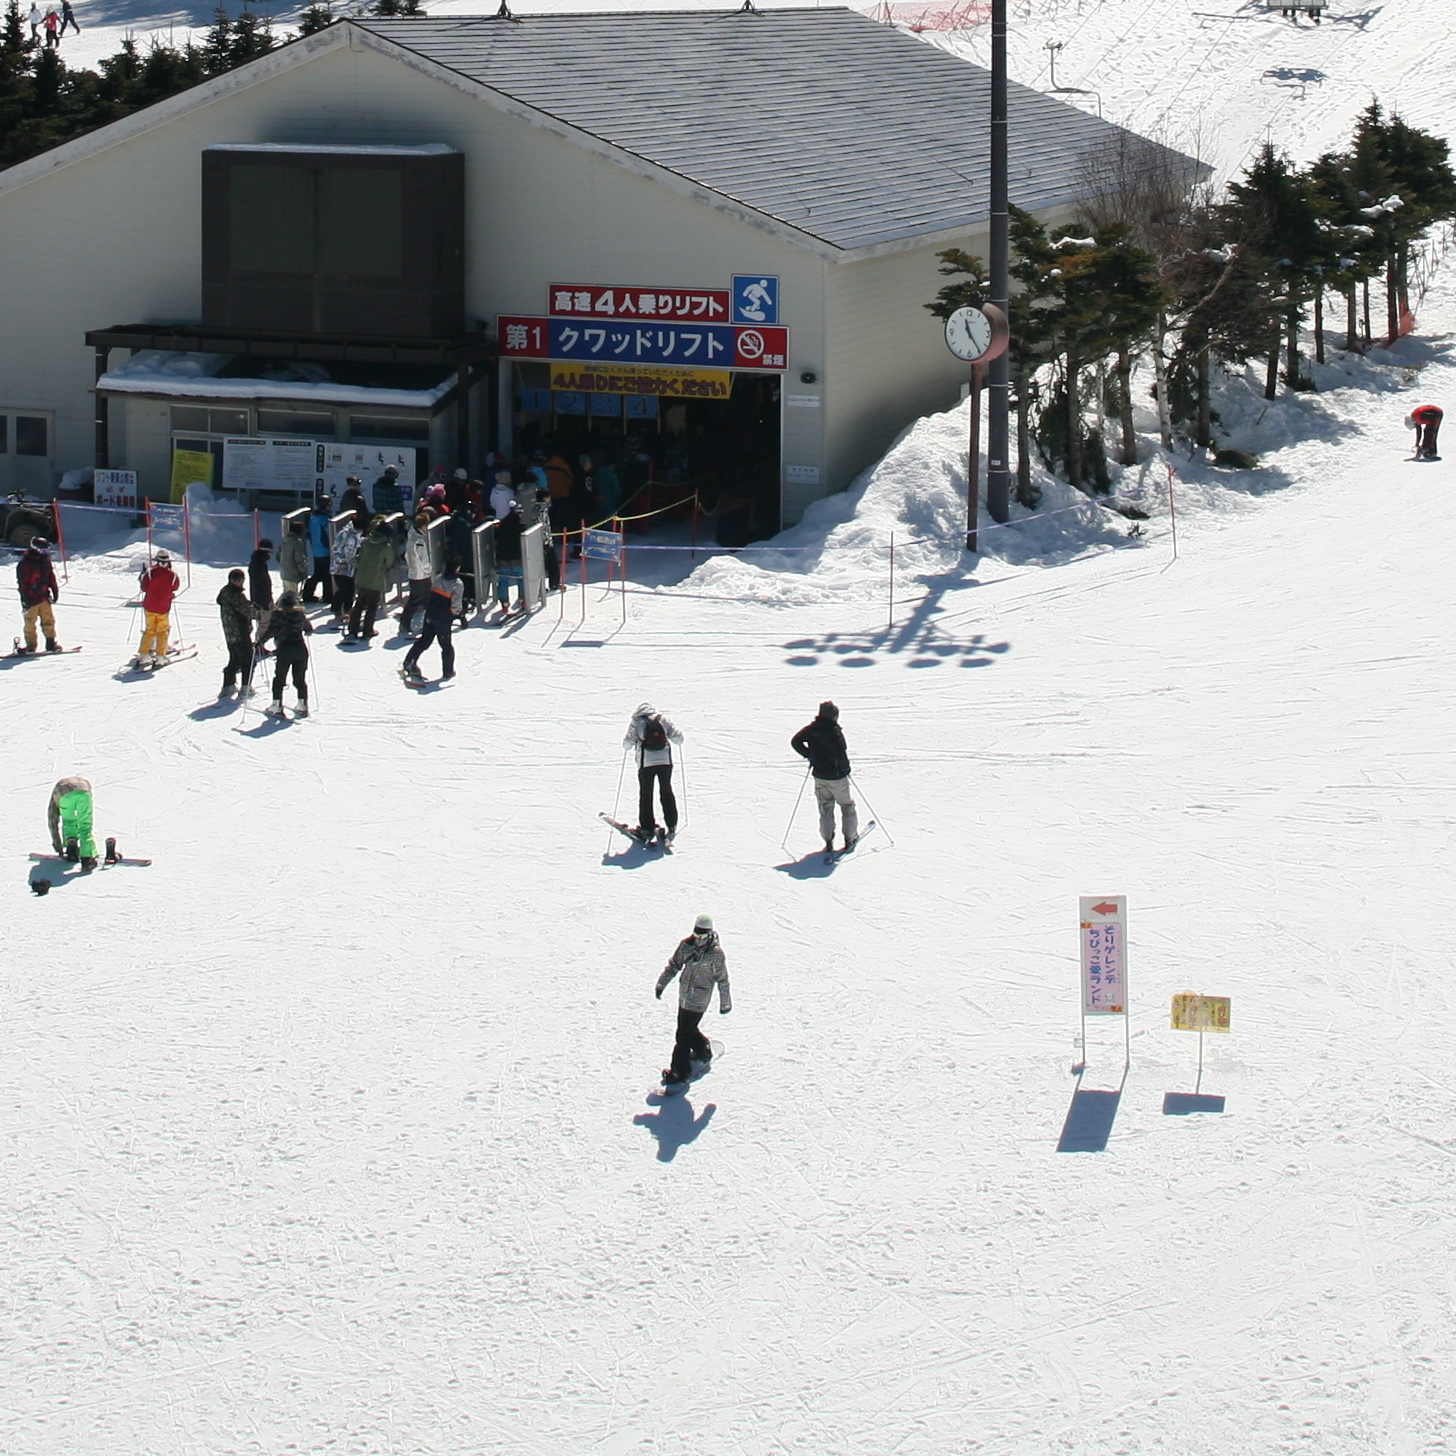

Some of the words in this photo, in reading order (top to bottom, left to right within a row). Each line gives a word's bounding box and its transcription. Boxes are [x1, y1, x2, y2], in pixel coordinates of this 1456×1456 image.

[554, 290, 724, 317] 高速4人乗りリフト
[966, 309, 973, 317] 12
[505, 324, 542, 350] 第1
[558, 326, 725, 359] クワッドリフト
[949, 328, 954, 336] 9
[967, 349, 972, 358] 6
[553, 372, 726, 396] 4人乗りにご協力ください
[533, 391, 539, 410] 1
[563, 394, 578, 412] 2
[598, 395, 612, 414] 3
[634, 397, 648, 415] 4
[1104, 925, 1116, 984] そりゲレンデ
